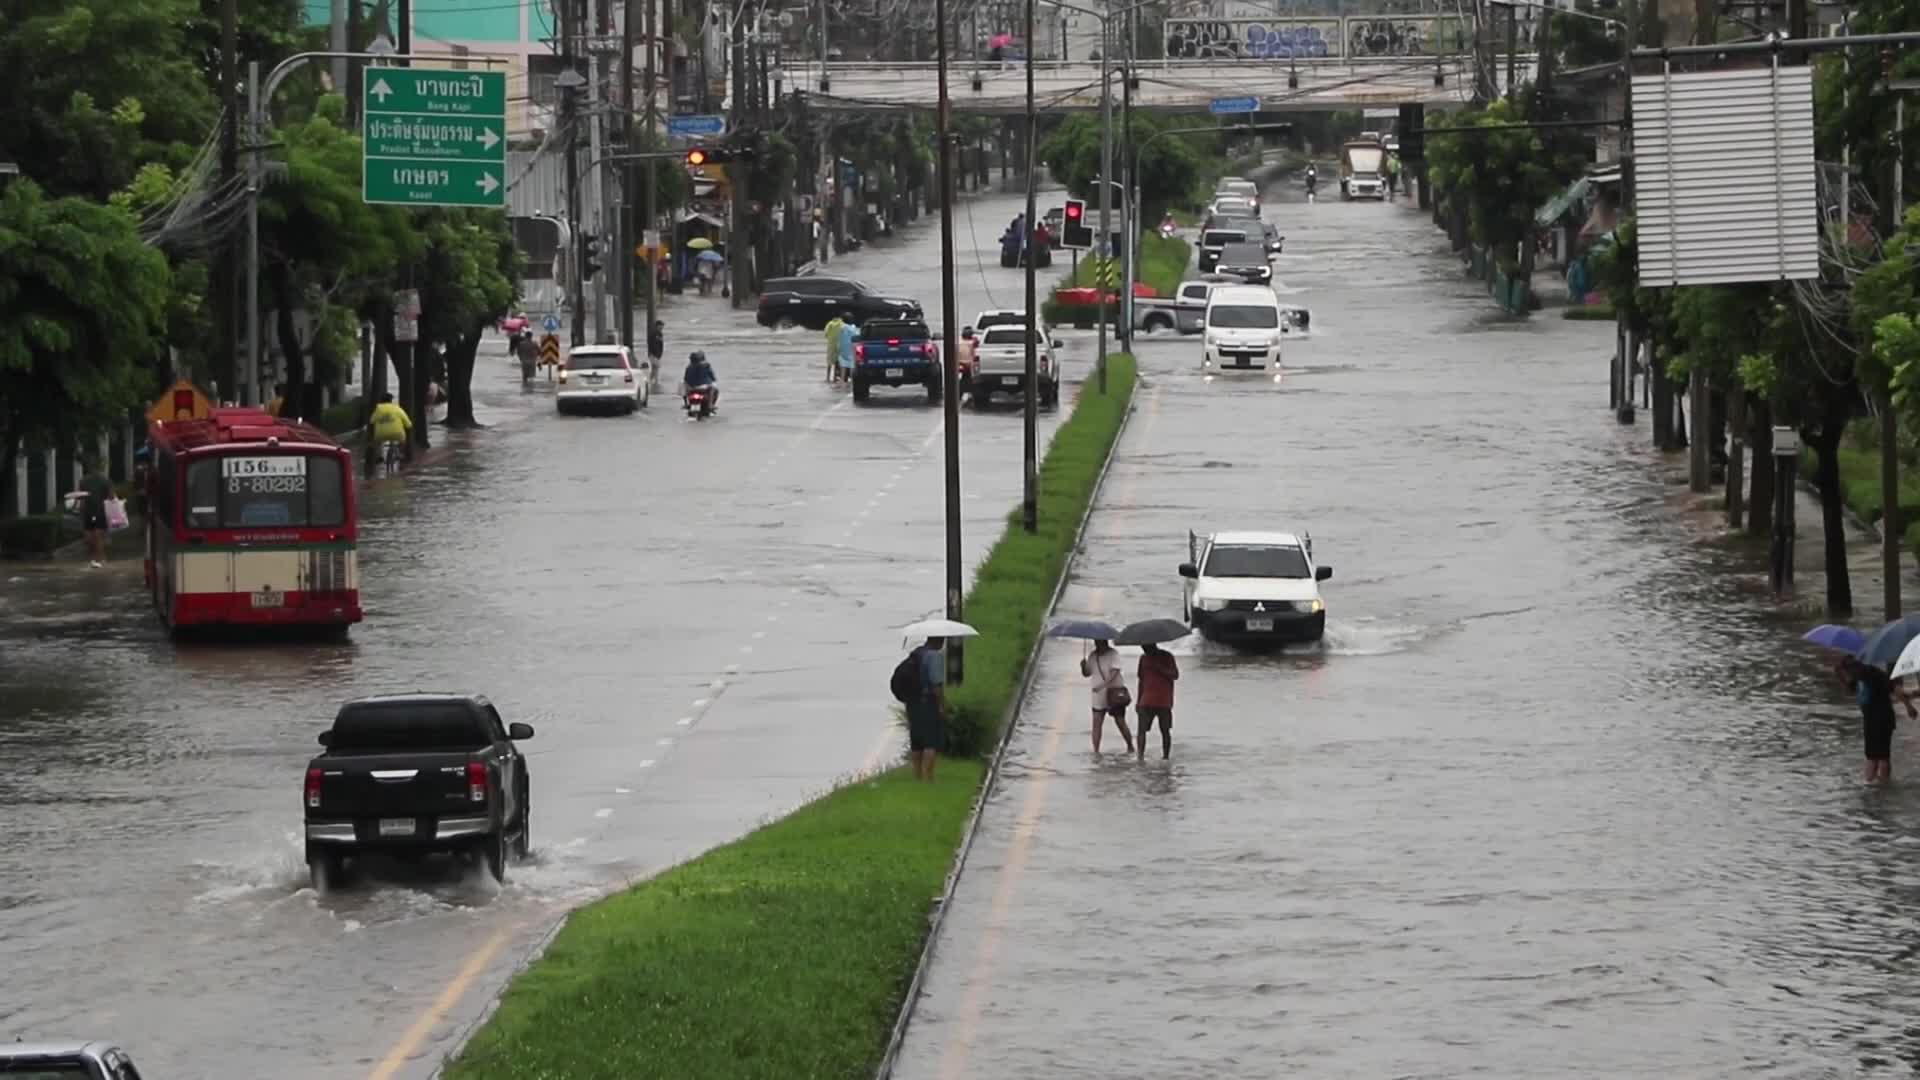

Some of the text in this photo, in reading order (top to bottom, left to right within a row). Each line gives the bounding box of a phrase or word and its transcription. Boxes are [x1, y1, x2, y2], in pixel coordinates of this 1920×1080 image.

[415, 75, 484, 97] บางกะปิ
[427, 101, 449, 112] Bang
[392, 168, 449, 185] เกษตร
[233, 460, 269, 474] 156
[229, 477, 306, 493] 8-80292
